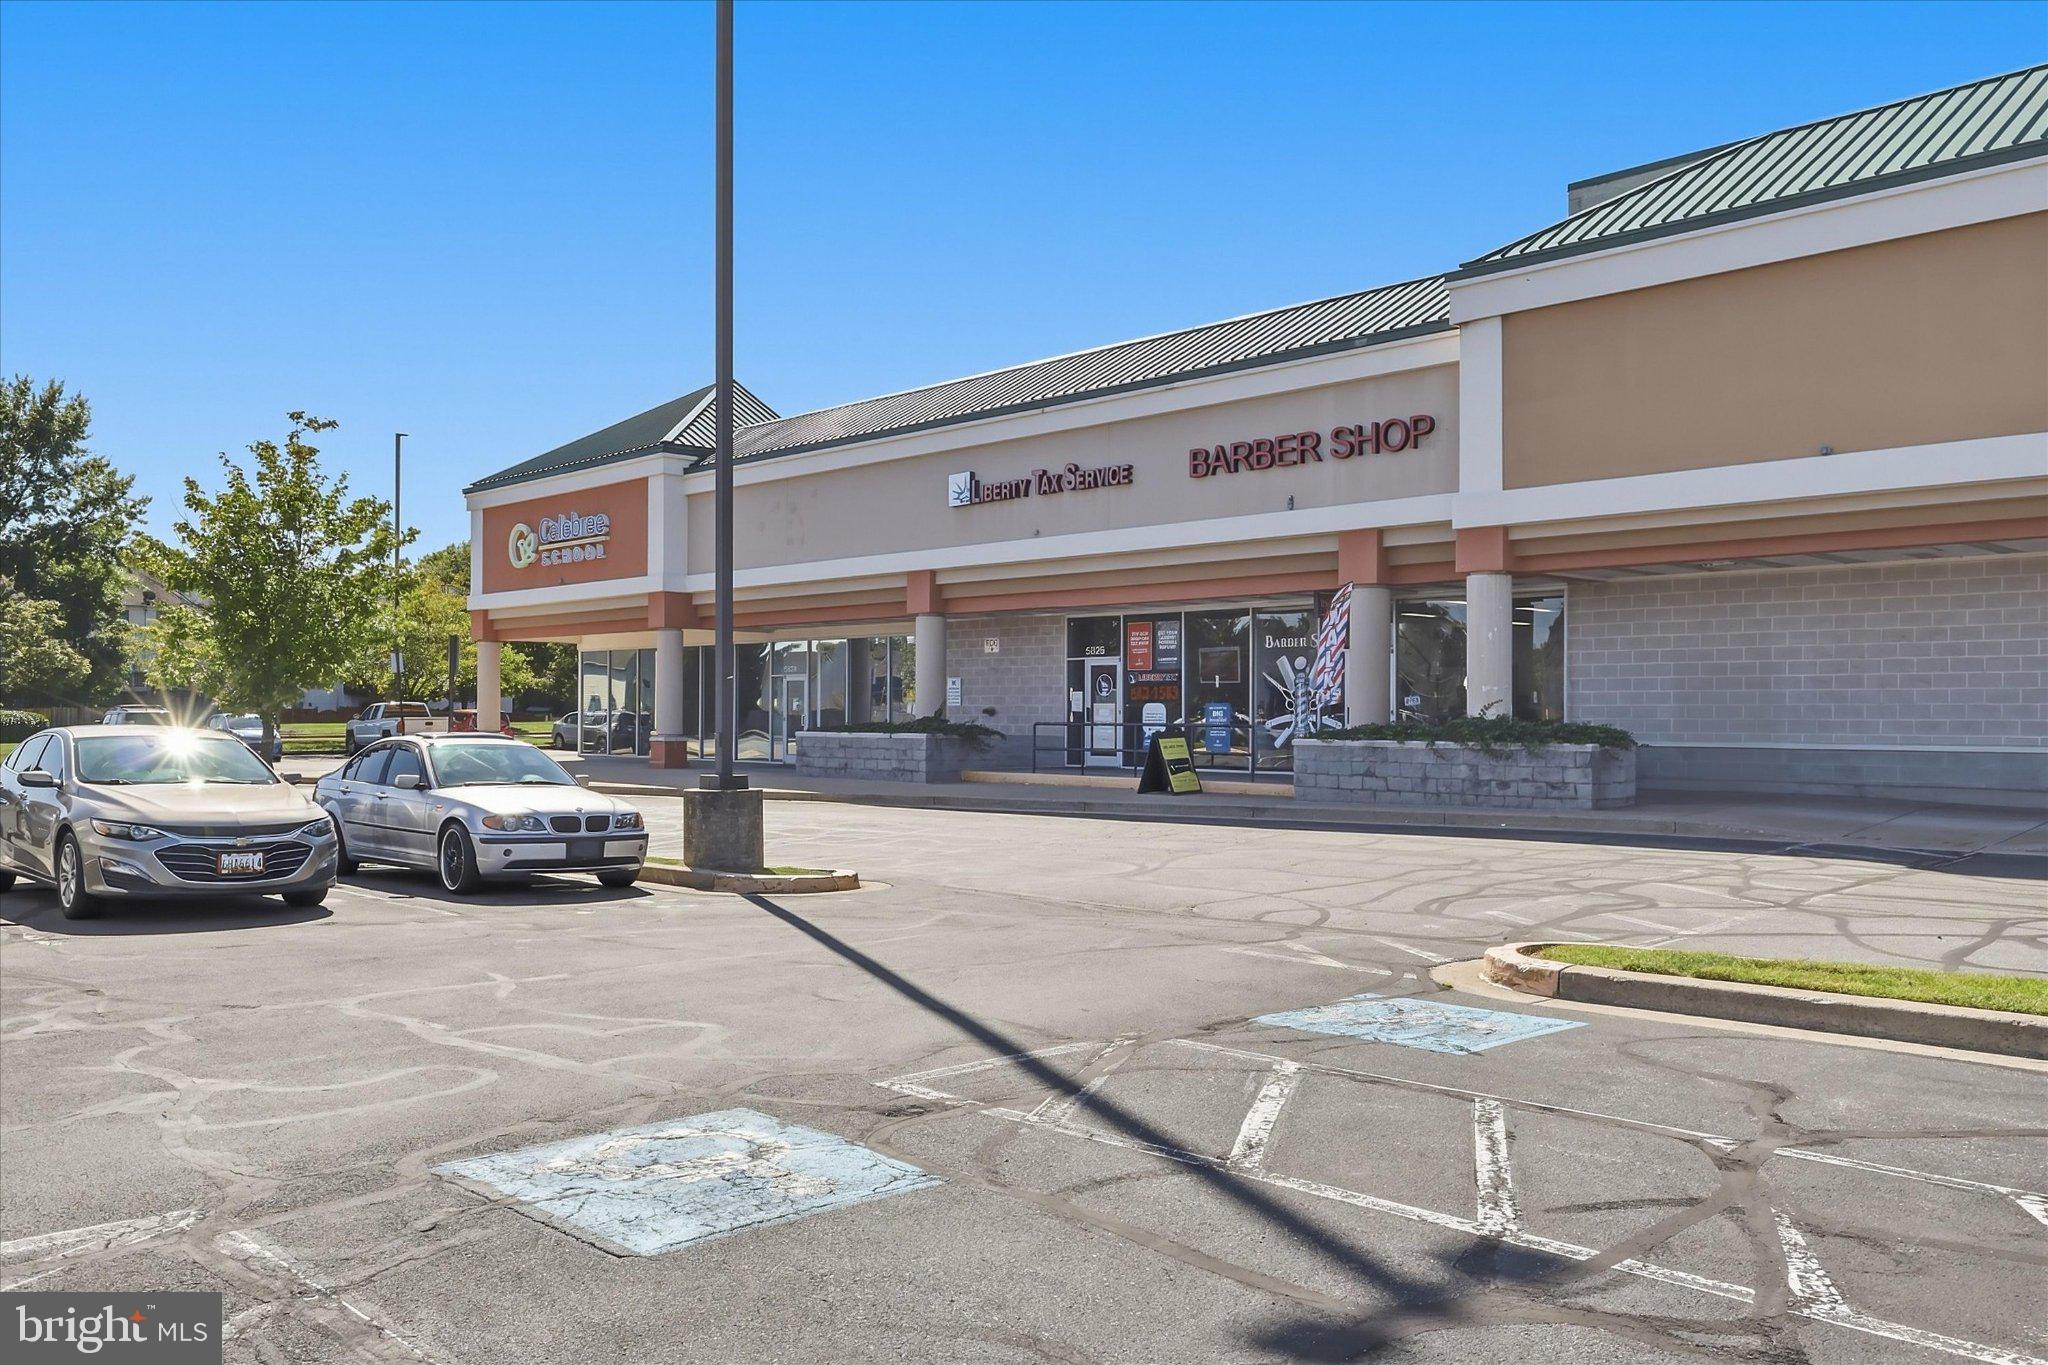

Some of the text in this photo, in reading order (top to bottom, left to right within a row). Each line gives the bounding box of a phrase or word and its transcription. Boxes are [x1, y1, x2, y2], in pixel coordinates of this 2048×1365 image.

[1189, 415, 1436, 478] BARBER SHOP
[971, 463, 1133, 504] LIBERTY TAX SERVICE
[539, 512, 610, 543] Celebree
[541, 544, 607, 566] SCHOOL
[1085, 645, 1106, 655] 5826
[1265, 635, 1308, 648] BARBER
